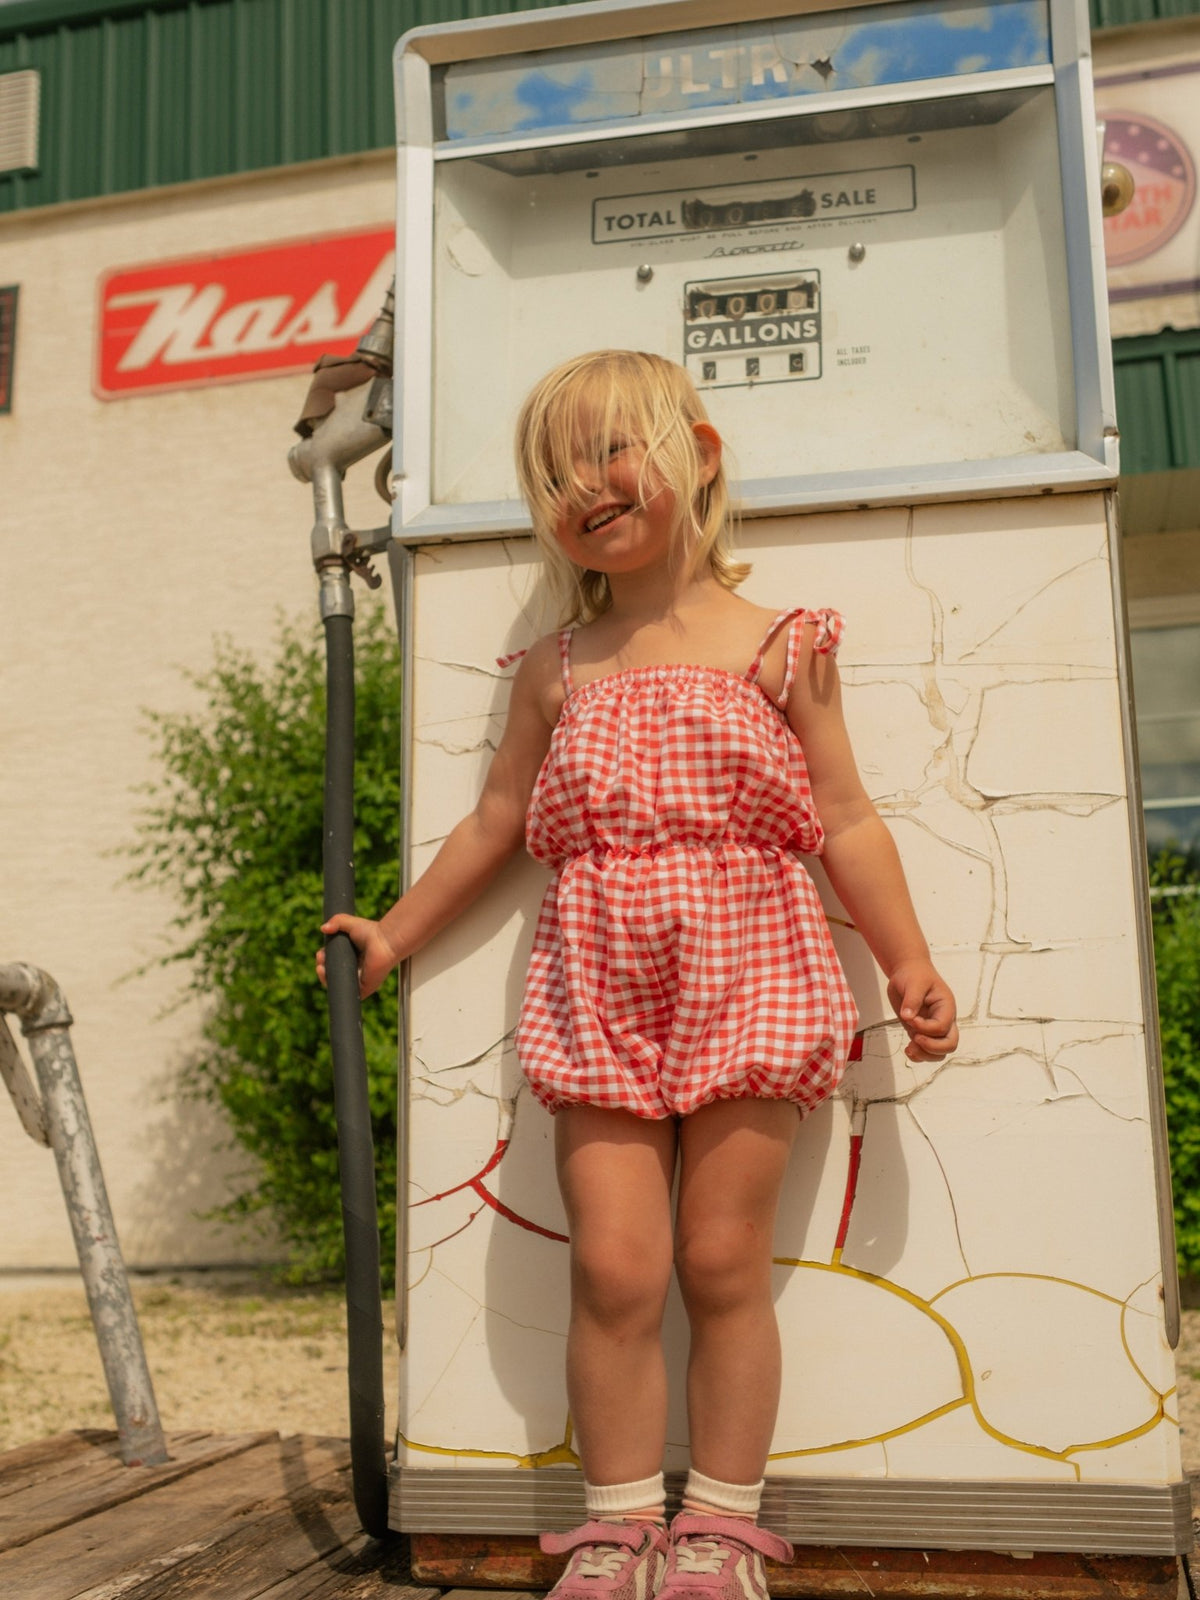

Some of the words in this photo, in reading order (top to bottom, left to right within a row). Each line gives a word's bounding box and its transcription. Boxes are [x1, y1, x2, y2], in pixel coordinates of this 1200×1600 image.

[604, 210, 676, 232] TOTAL
[820, 188, 877, 209] SALE
[703, 240, 806, 259] Bennett
[687, 319, 818, 349] GALLONS
